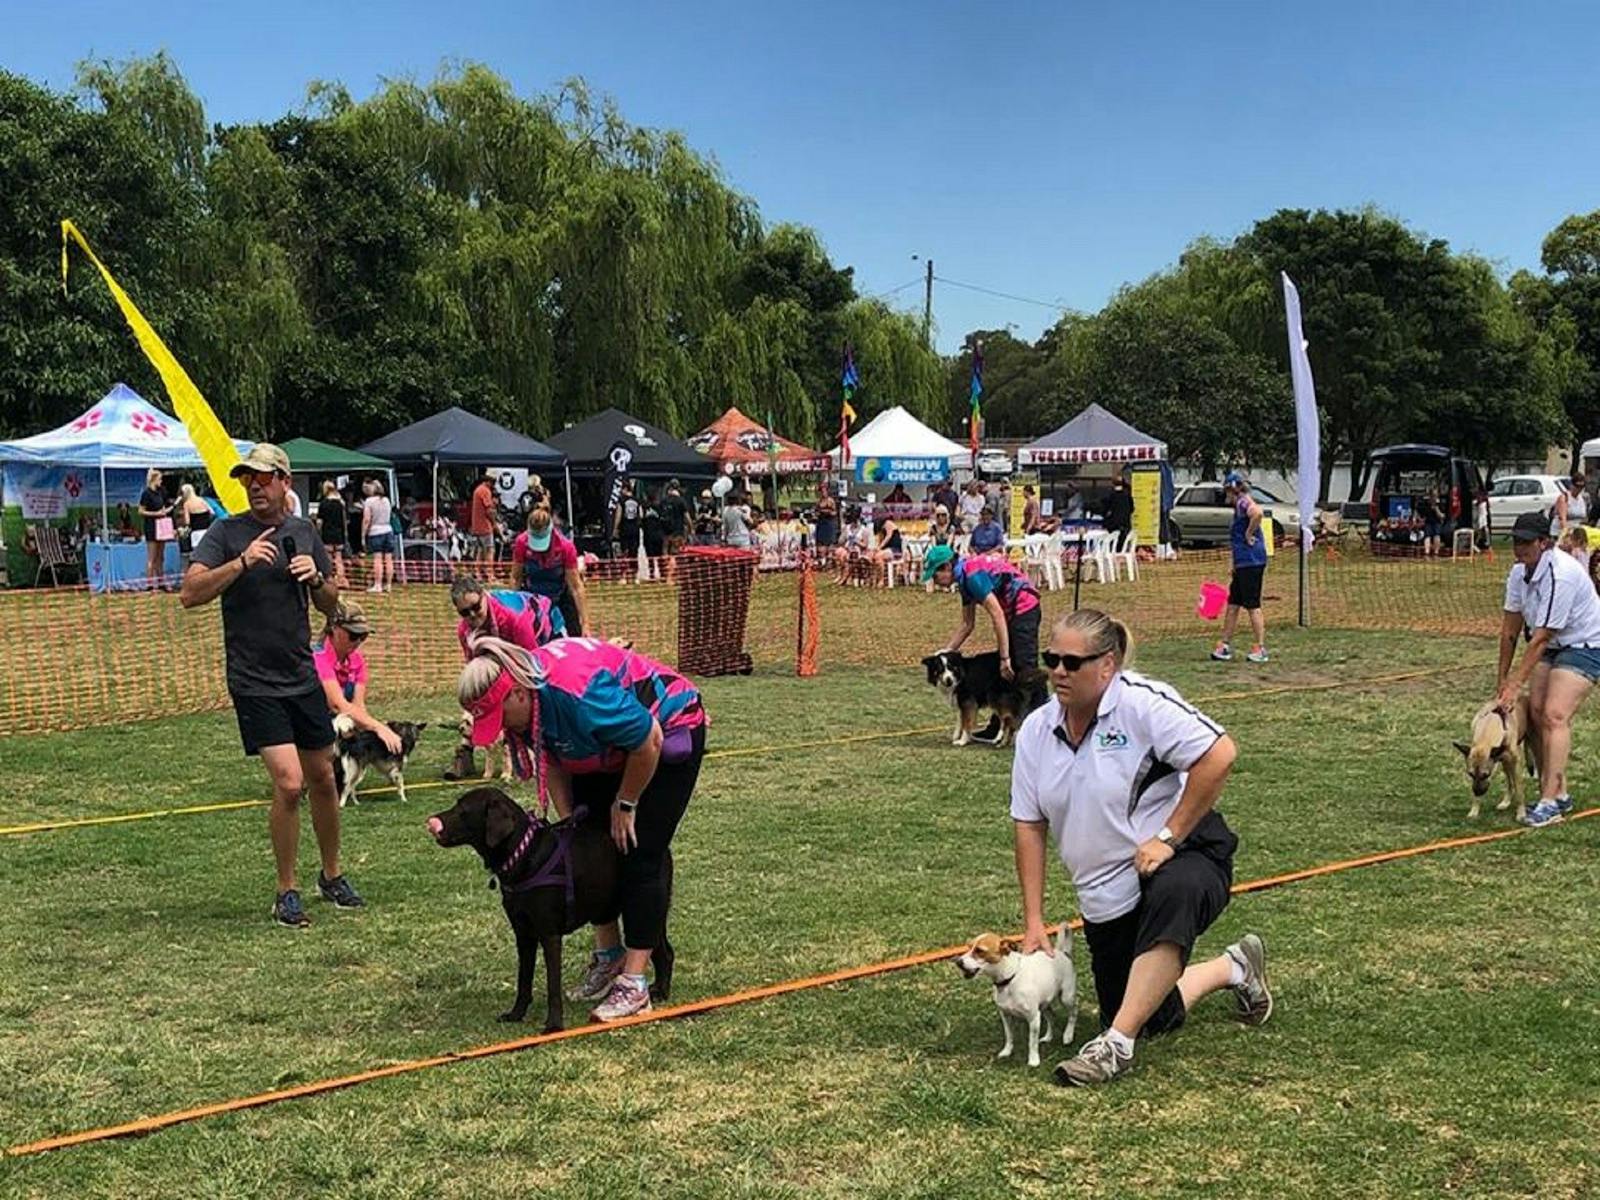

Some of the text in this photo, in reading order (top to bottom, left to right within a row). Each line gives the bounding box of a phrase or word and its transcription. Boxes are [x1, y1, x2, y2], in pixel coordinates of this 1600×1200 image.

[1030, 449, 1087, 462] TURKISH
[890, 460, 941, 470] SNOW
[888, 471, 944, 481] CONES
